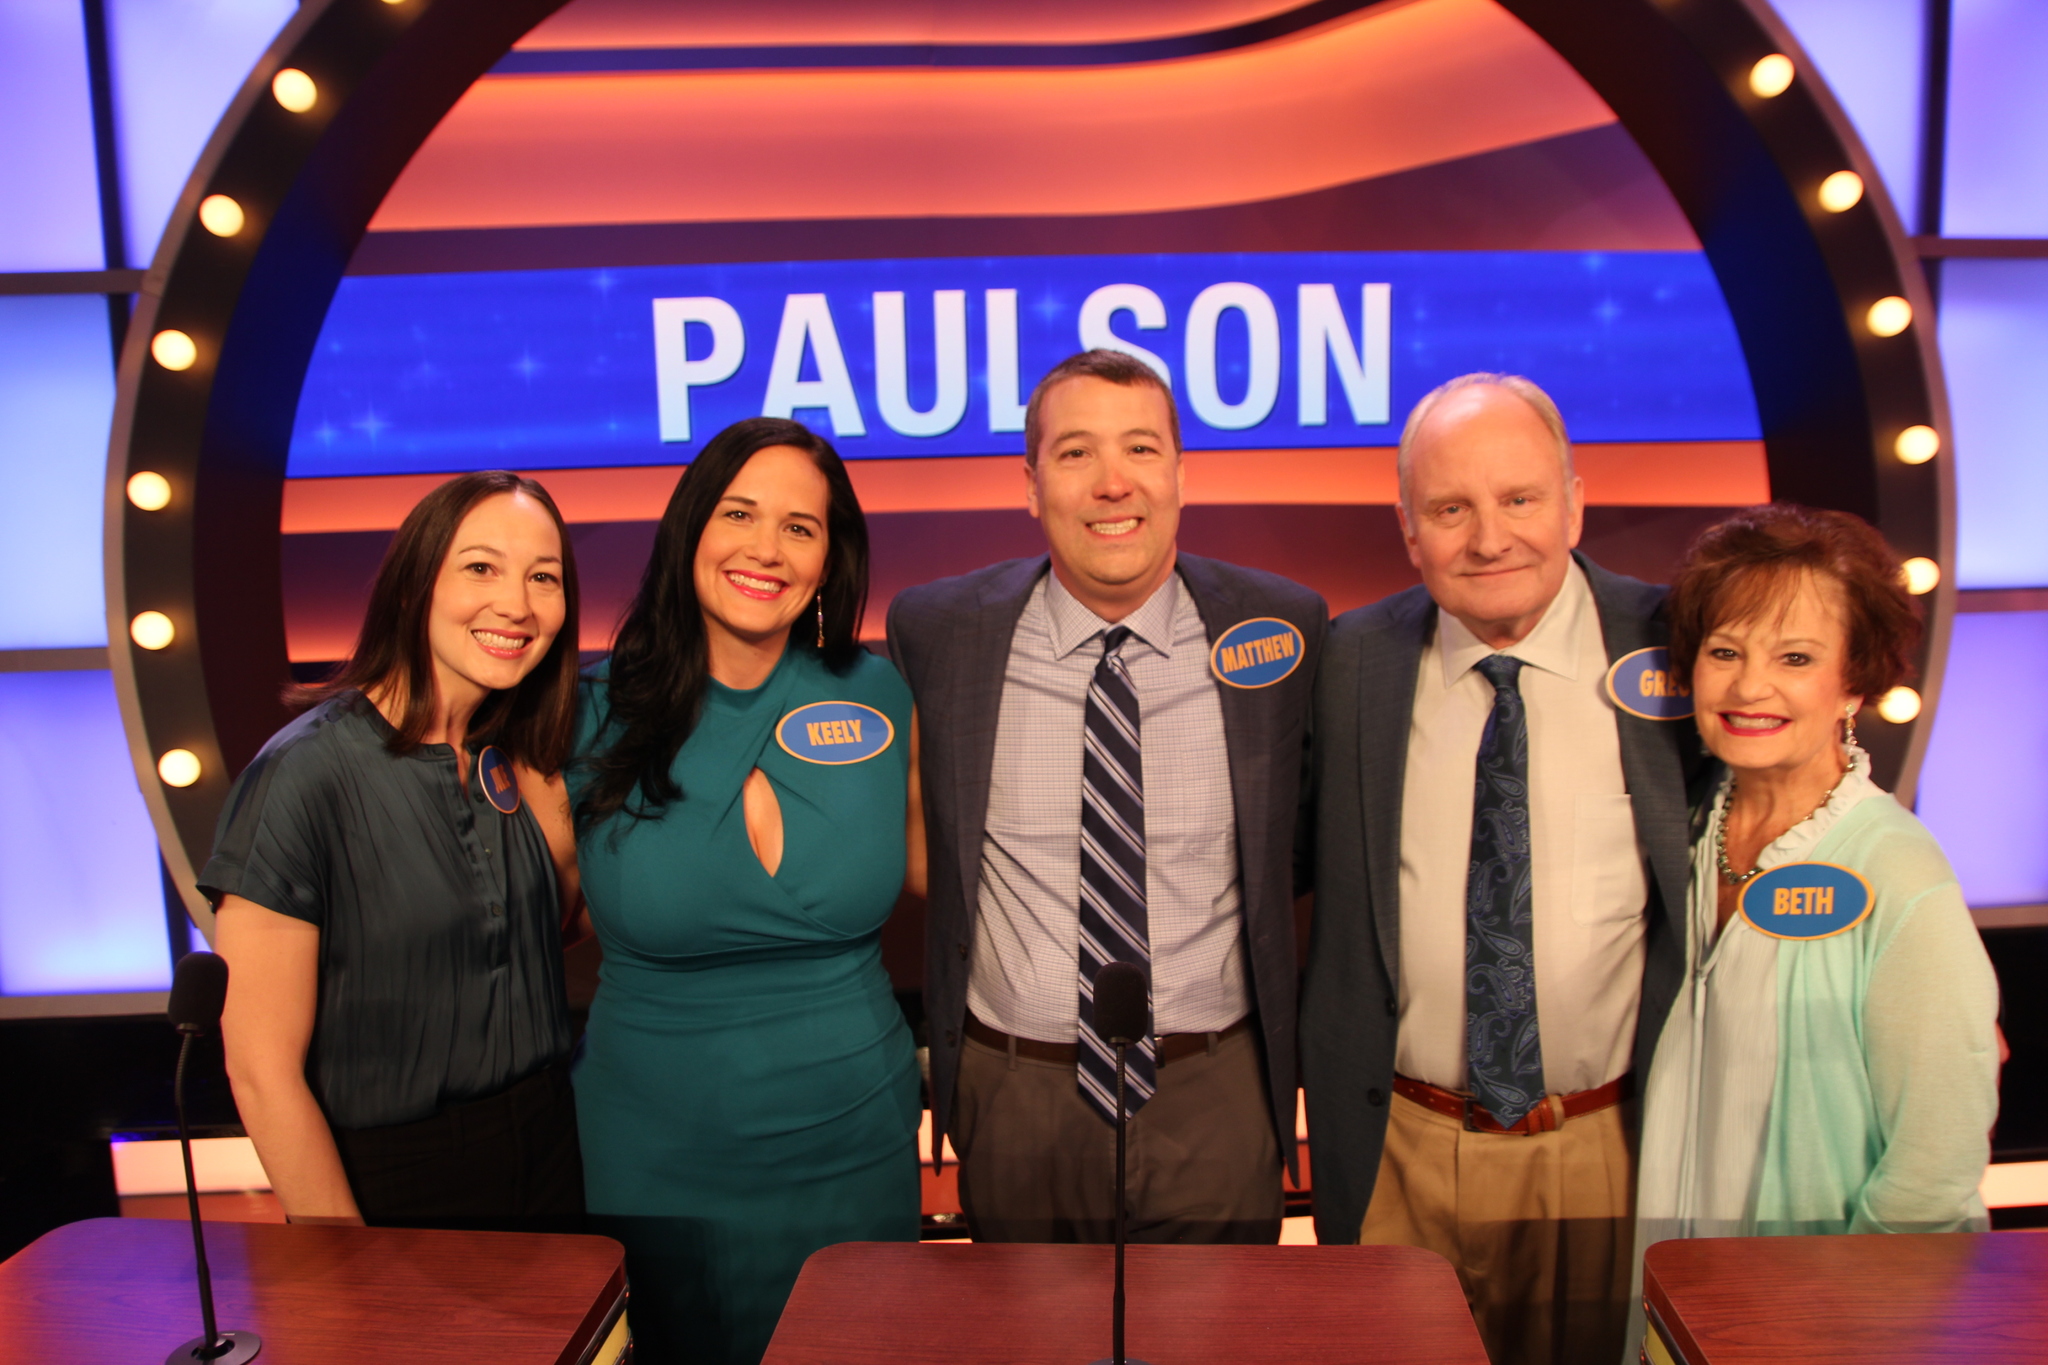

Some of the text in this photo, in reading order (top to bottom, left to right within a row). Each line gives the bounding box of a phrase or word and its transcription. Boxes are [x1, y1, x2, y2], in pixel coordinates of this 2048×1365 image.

[653, 282, 1391, 442] PAULSON
[1221, 632, 1295, 673] MATTHEW
[806, 719, 862, 746] KEELY
[1773, 887, 1834, 915] BETH
